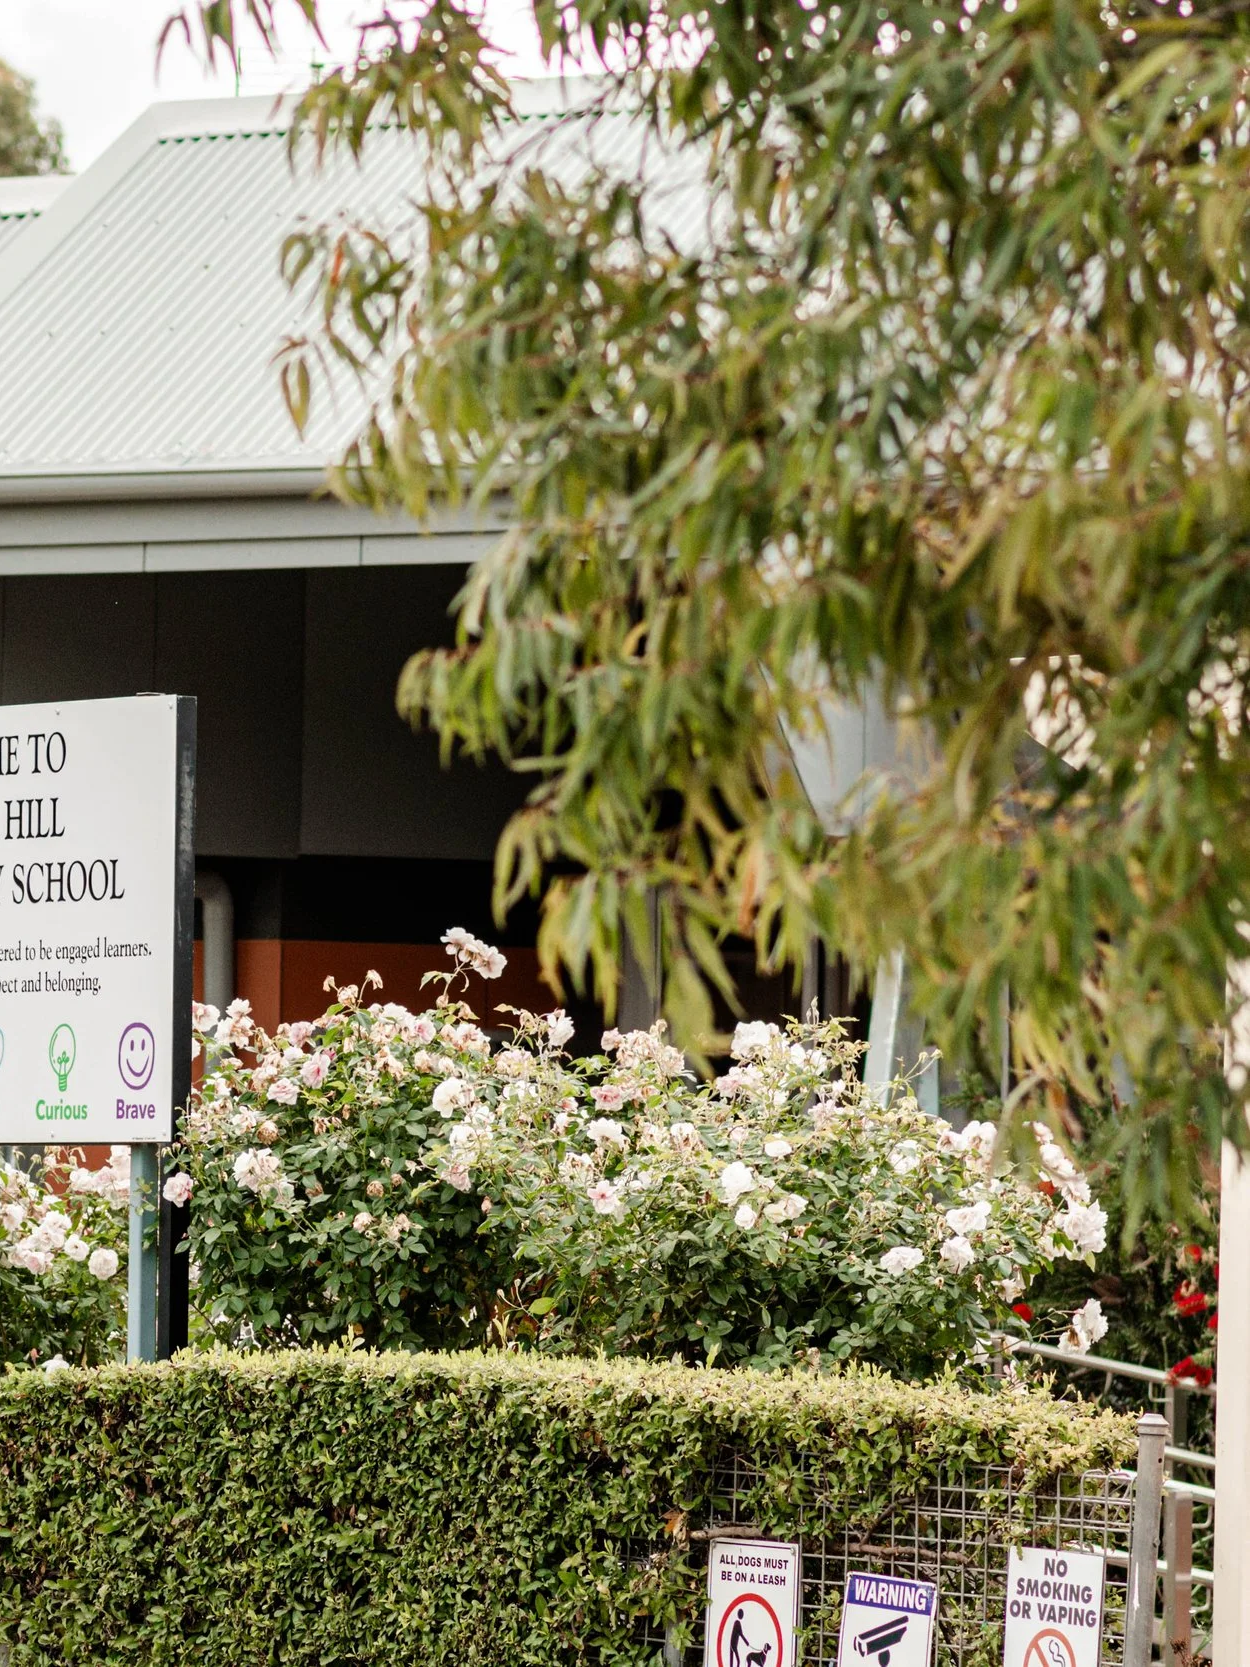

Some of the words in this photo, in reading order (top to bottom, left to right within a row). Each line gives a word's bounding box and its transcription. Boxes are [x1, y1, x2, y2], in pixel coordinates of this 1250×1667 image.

[27, 731, 66, 773] TO
[4, 797, 65, 840] HILL
[12, 859, 125, 904] SCHOOL
[25, 944, 36, 960] to
[39, 939, 52, 960] be
[55, 937, 100, 964] engaged
[103, 936, 152, 958] learners.
[21, 971, 42, 993] and
[45, 971, 102, 996] belonging.
[35, 1099, 88, 1121] Curious
[116, 1098, 156, 1120] Brave
[719, 1554, 735, 1565] ALL
[738, 1556, 762, 1567] DOGS
[764, 1558, 789, 1570] MUST
[1044, 1557, 1068, 1578] NO
[721, 1570, 732, 1581] BE
[734, 1572, 747, 1582] ON
[749, 1573, 756, 1583] A
[758, 1574, 786, 1586] LEASH
[1016, 1577, 1093, 1604] SMOKING
[855, 1579, 927, 1611] WARNING
[1009, 1600, 1031, 1619] OR
[1037, 1603, 1097, 1628] VAPING
